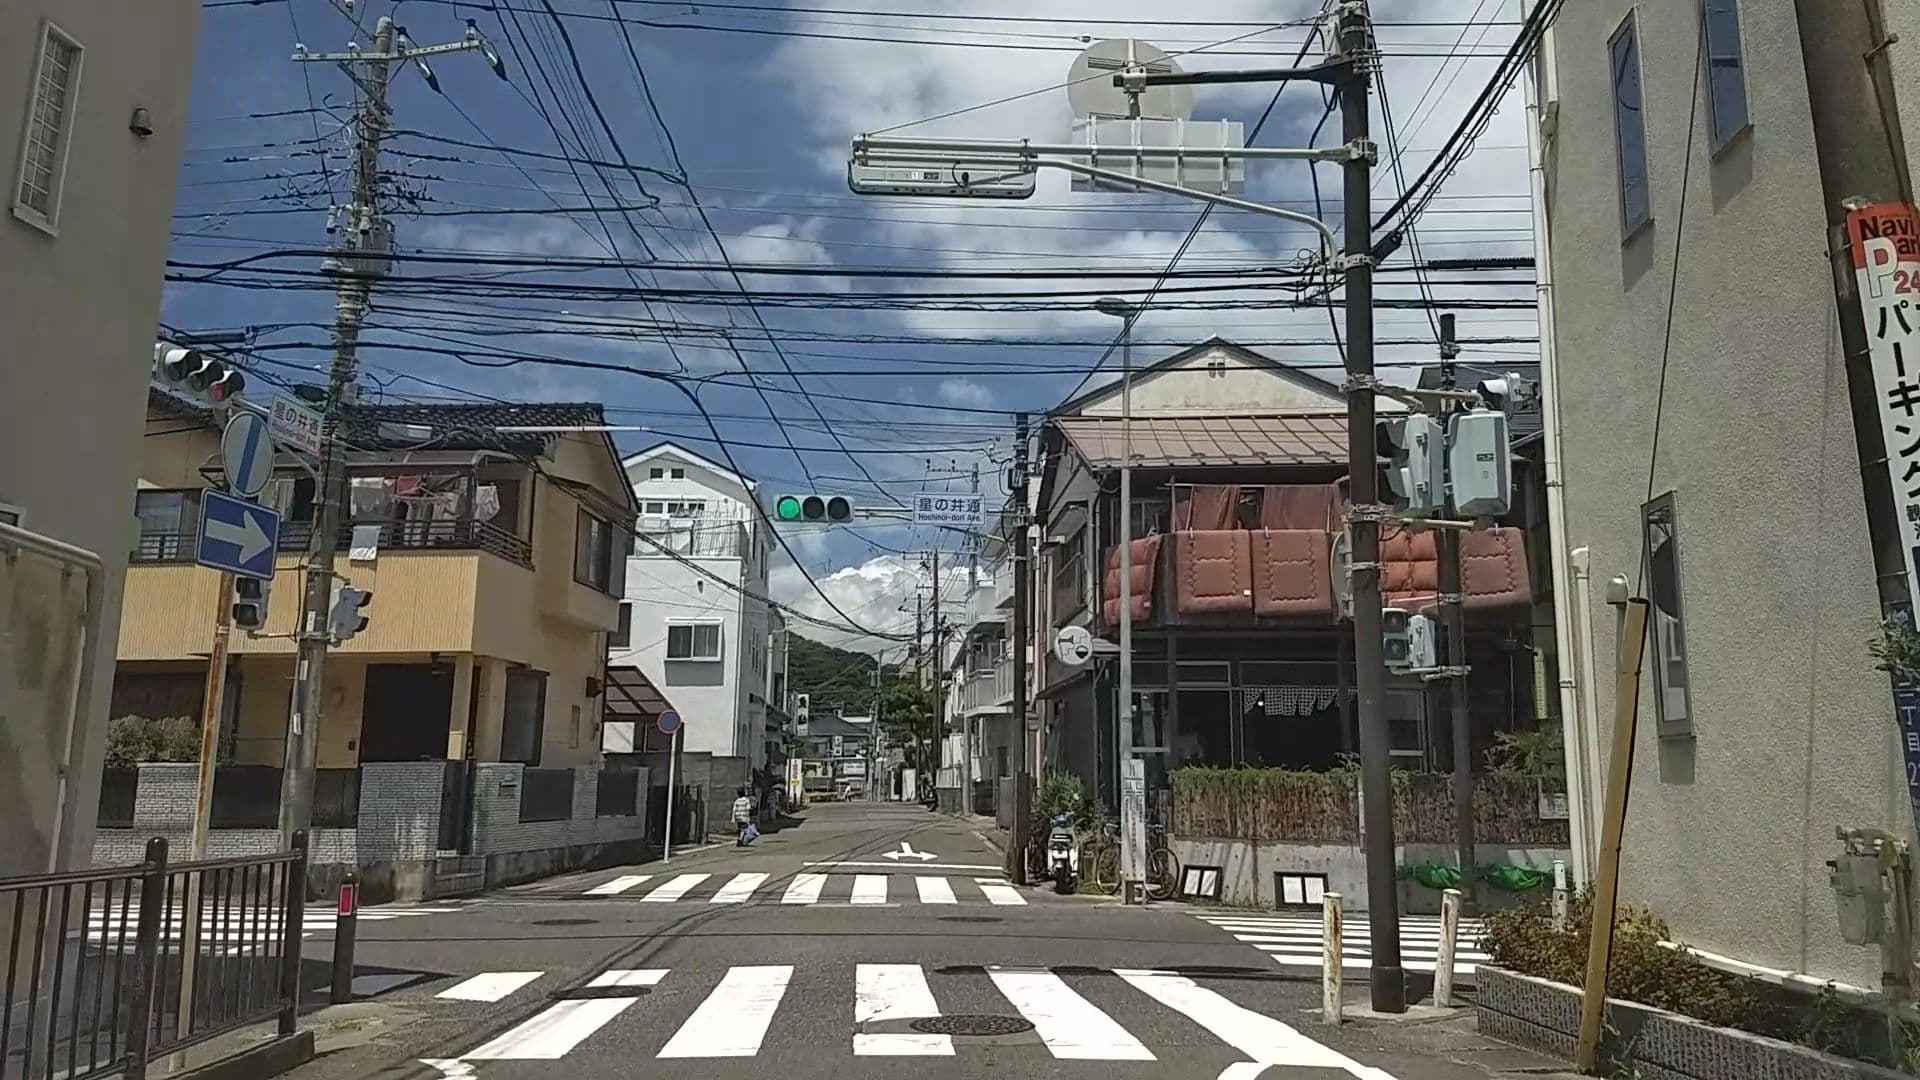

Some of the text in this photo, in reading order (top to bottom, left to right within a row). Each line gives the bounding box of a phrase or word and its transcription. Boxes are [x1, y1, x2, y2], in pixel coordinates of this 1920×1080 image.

[1859, 213, 1914, 239] Navi
[274, 401, 319, 437] 星の井通
[919, 498, 980, 512] 星の井通
